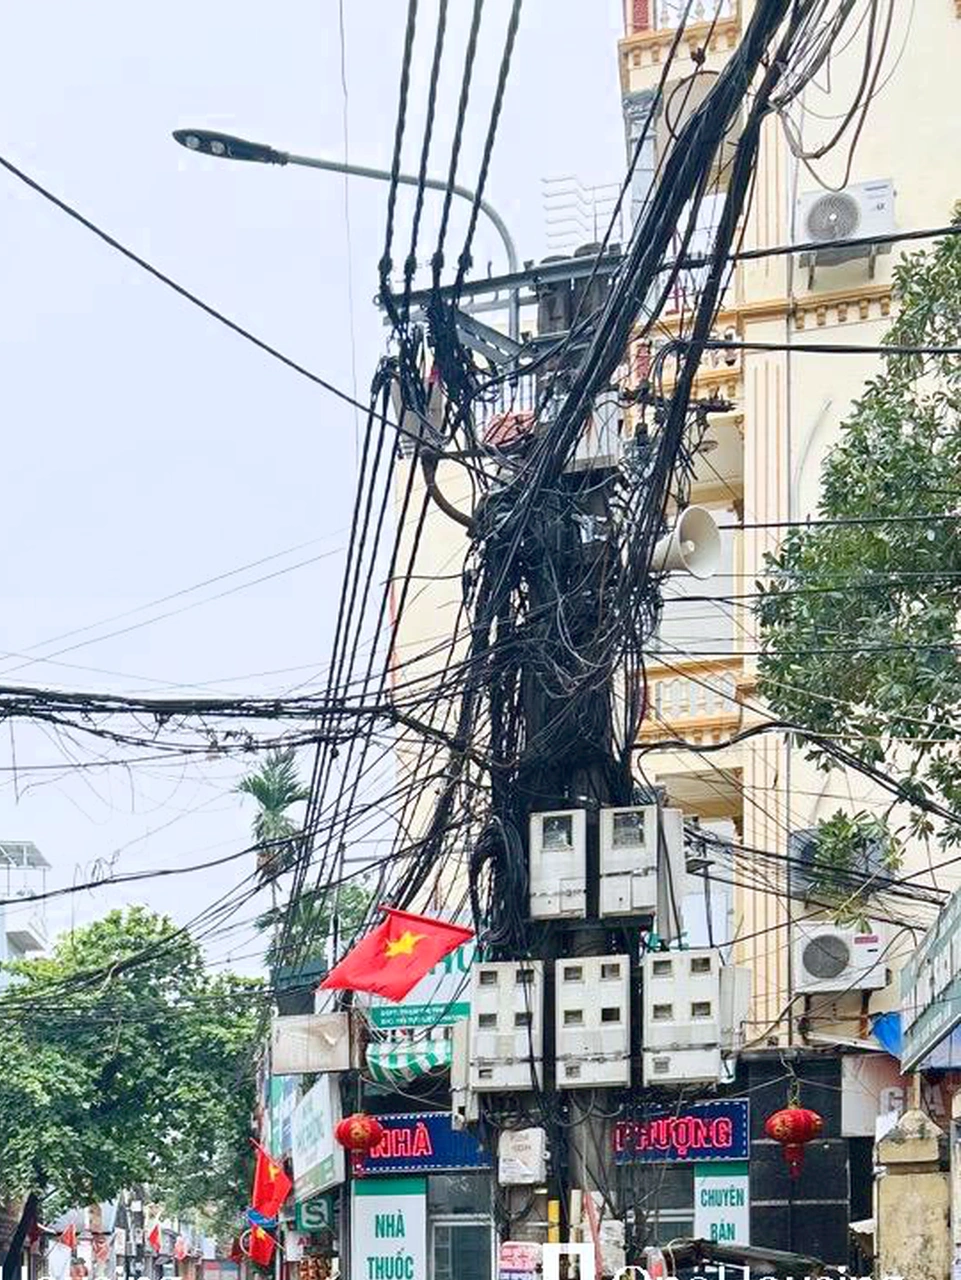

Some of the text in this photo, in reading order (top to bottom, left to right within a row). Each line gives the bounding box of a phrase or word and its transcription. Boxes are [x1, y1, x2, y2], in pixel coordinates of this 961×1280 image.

[370, 1121, 433, 1158] NHÀ
[701, 1187, 744, 1207] CHUYÊN
[375, 1210, 405, 1238] NHÀ
[710, 1220, 735, 1242] BÁN
[367, 1247, 414, 1280] THUỐC
